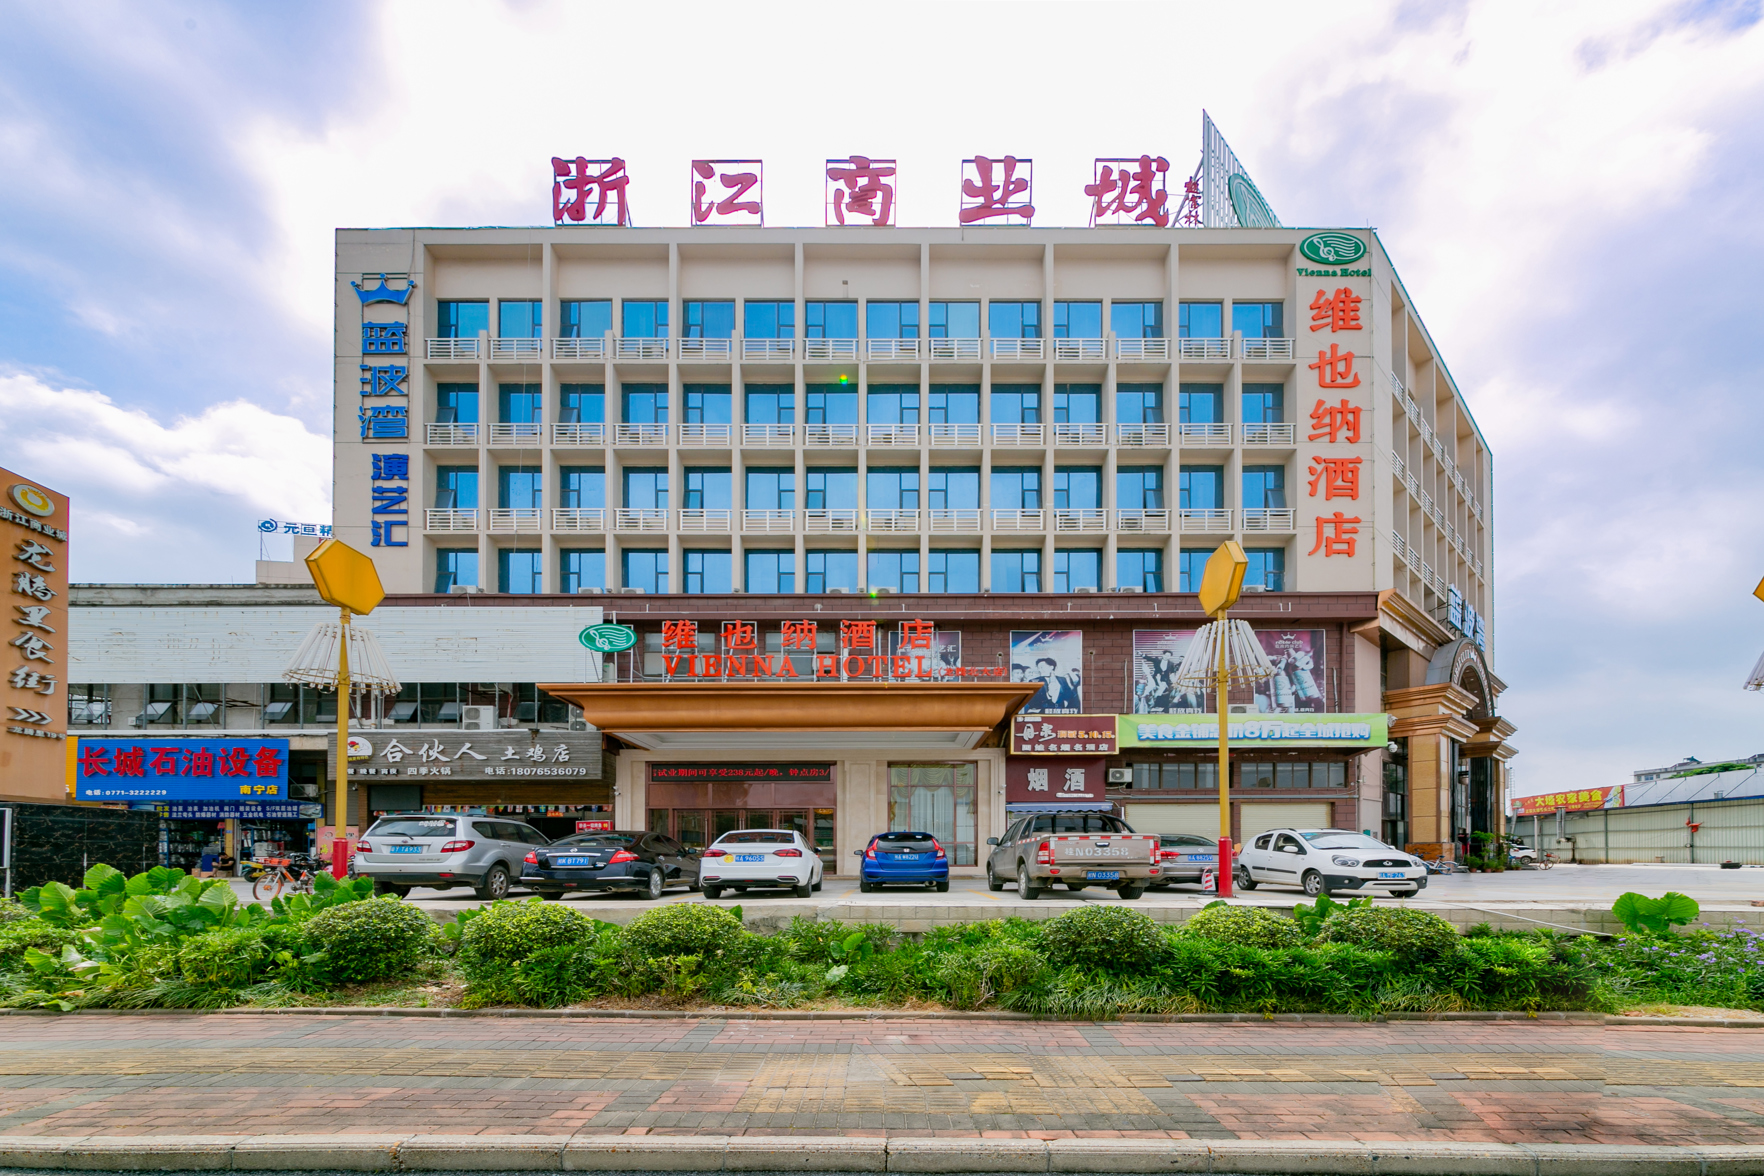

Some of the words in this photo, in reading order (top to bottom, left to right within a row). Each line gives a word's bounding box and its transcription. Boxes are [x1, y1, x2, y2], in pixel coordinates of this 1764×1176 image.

[551, 155, 1169, 227] 浙江商业城
[1297, 268, 1338, 277] Vienna
[1340, 268, 1372, 277] Hotel
[358, 321, 408, 438] 蓝波湾
[1308, 286, 1364, 558] 维也纳酒店
[371, 453, 409, 547] 演艺汇
[0, 506, 68, 542] 浙江商业城
[662, 619, 935, 650] 维也纳酒店
[662, 655, 799, 678] VIENNA
[816, 655, 933, 678] HOTEL
[78, 746, 282, 778] 长城石油设备
[380, 738, 488, 762] 合伙人
[500, 744, 570, 762] 土鸡店
[408, 767, 452, 775] 四季火锅
[1028, 768, 1085, 792] 烟酒
[240, 785, 278, 795] 南宁店
